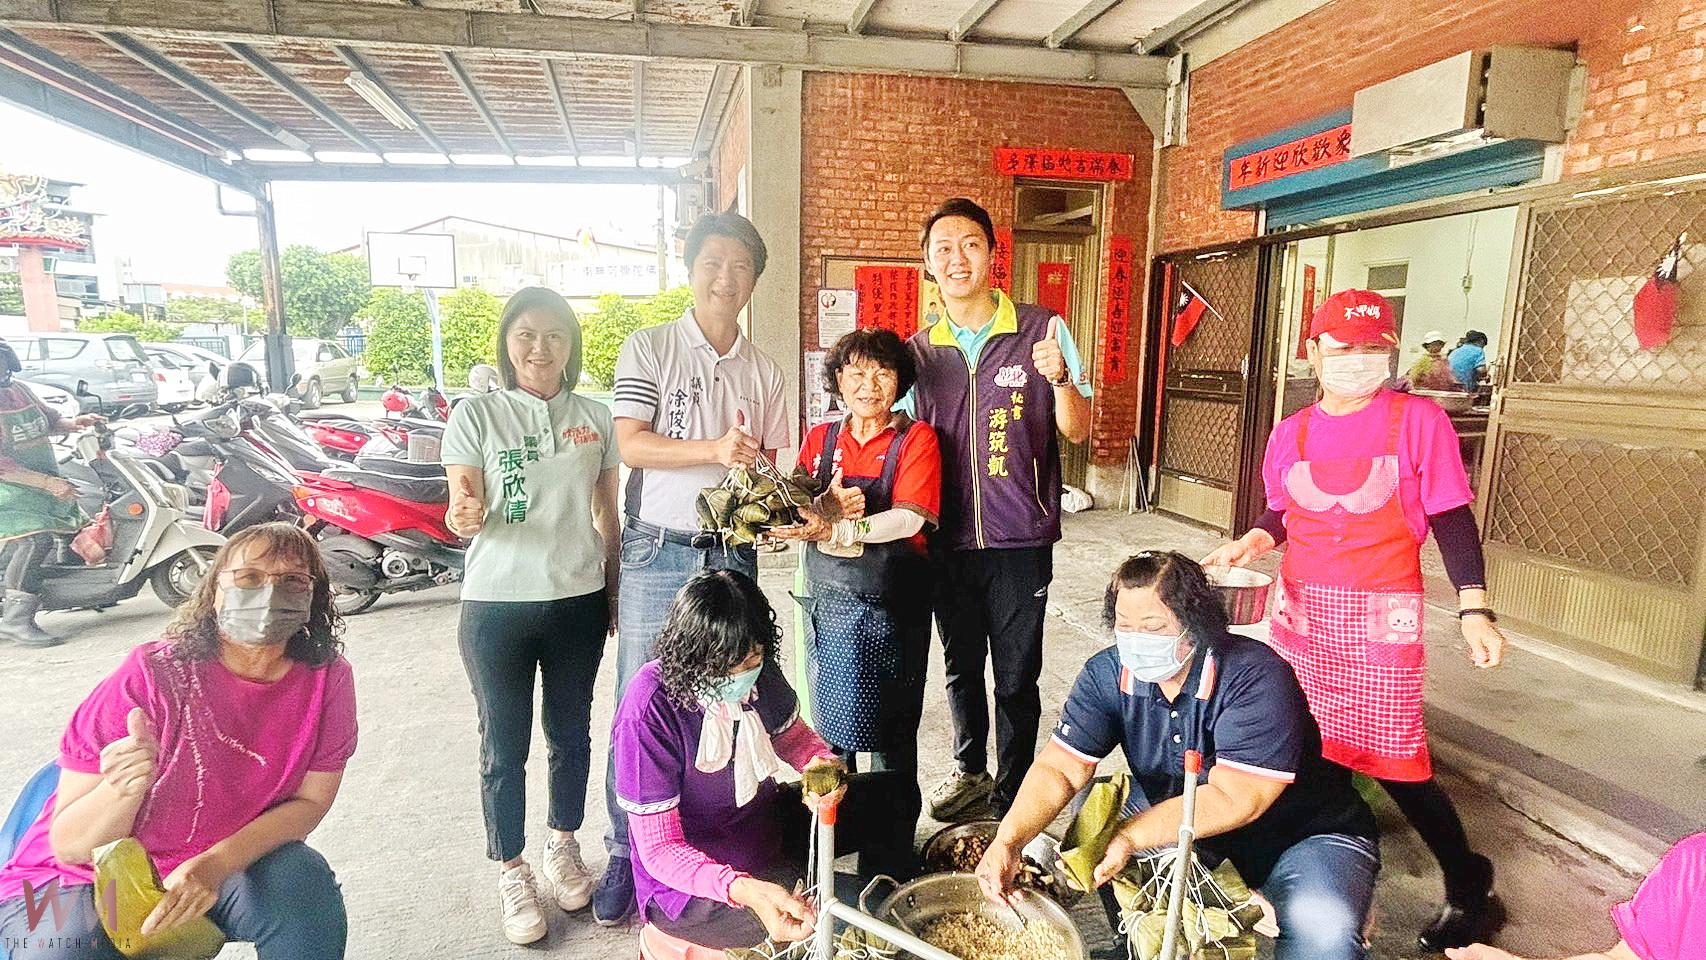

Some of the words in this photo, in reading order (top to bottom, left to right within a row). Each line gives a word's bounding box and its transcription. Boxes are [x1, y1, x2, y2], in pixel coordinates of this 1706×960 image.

[691, 376, 703, 408] 議員
[987, 407, 1008, 477] 游筑凱
[498, 448, 527, 524] 張欣倩
